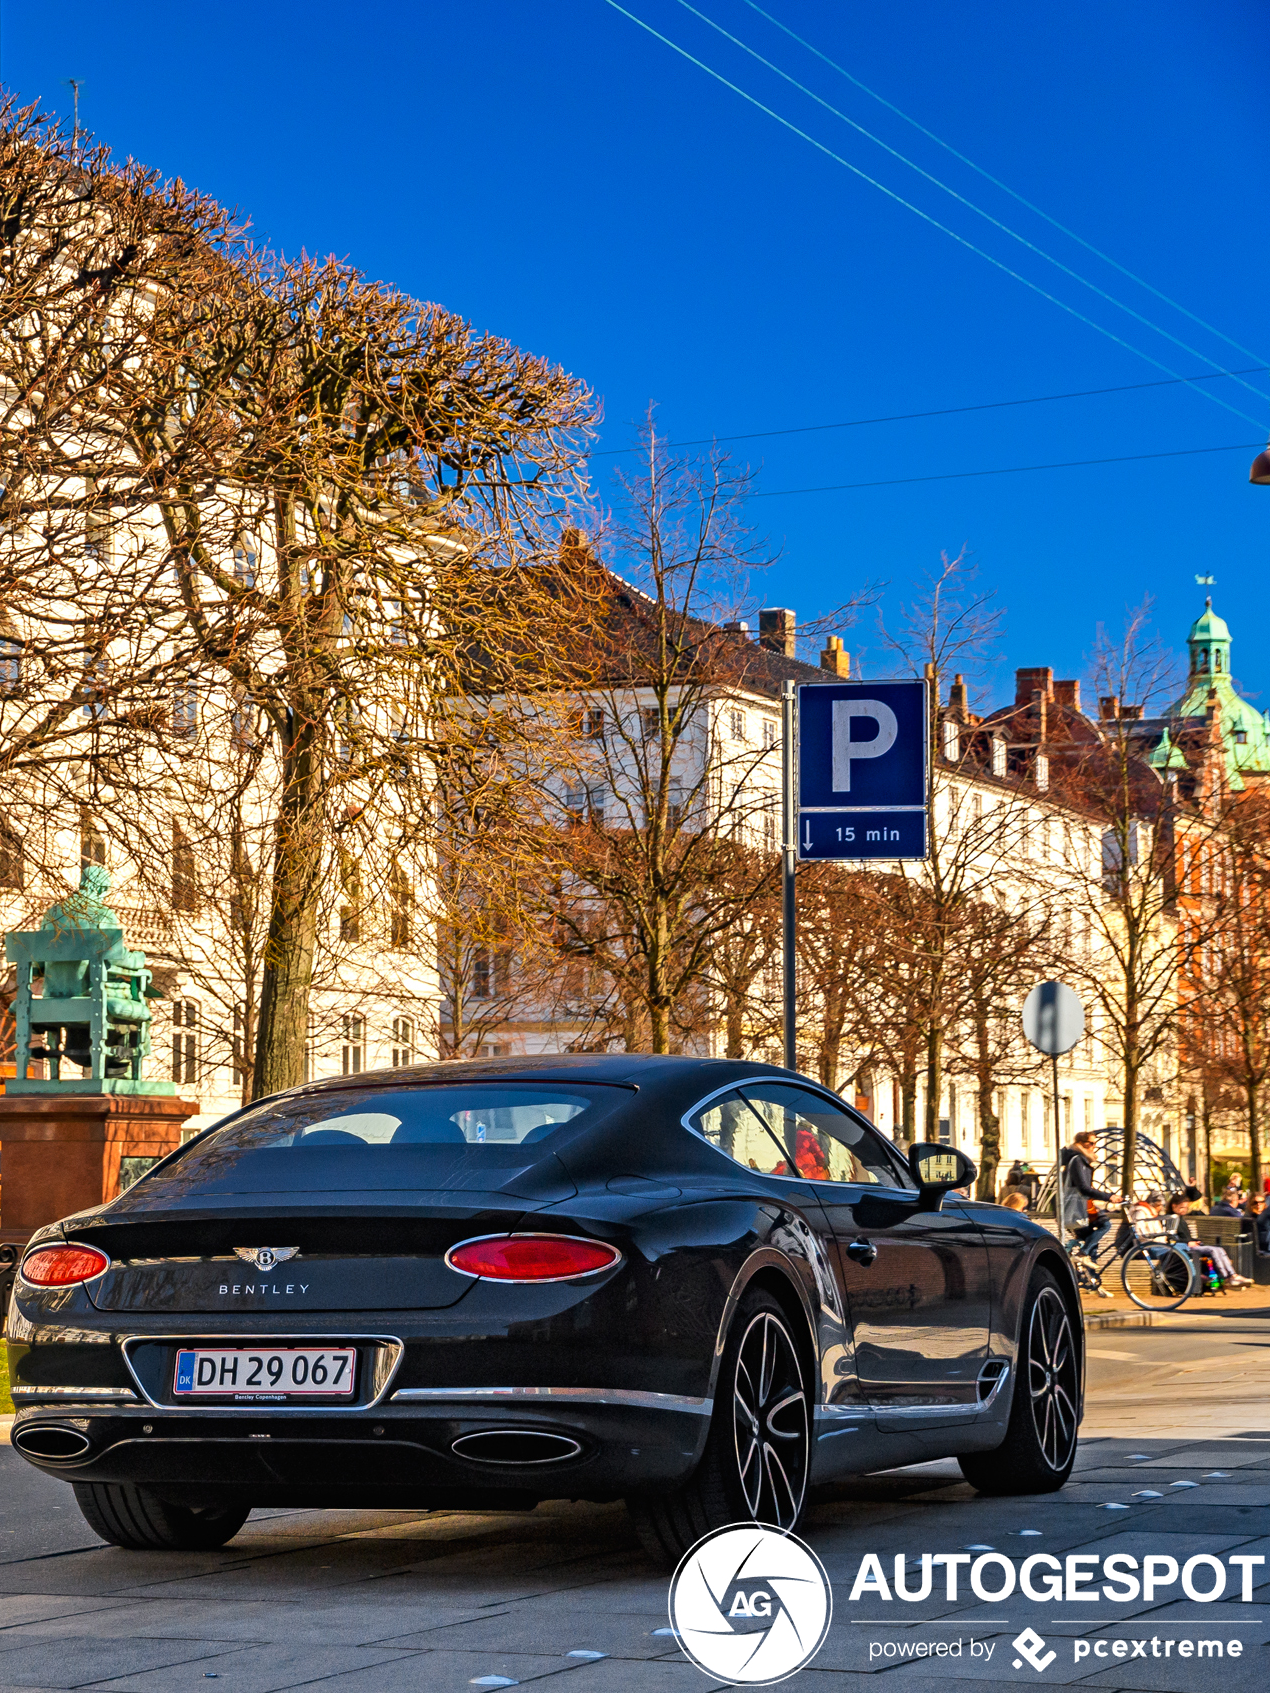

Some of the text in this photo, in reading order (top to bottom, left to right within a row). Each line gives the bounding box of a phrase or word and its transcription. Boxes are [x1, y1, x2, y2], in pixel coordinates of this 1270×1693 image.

[832, 699, 898, 792] P
[836, 827, 900, 842] 15 min
[219, 1284, 309, 1294] BENTLEY
[197, 1354, 349, 1387] DH 29 067
[179, 1375, 191, 1385] DK
